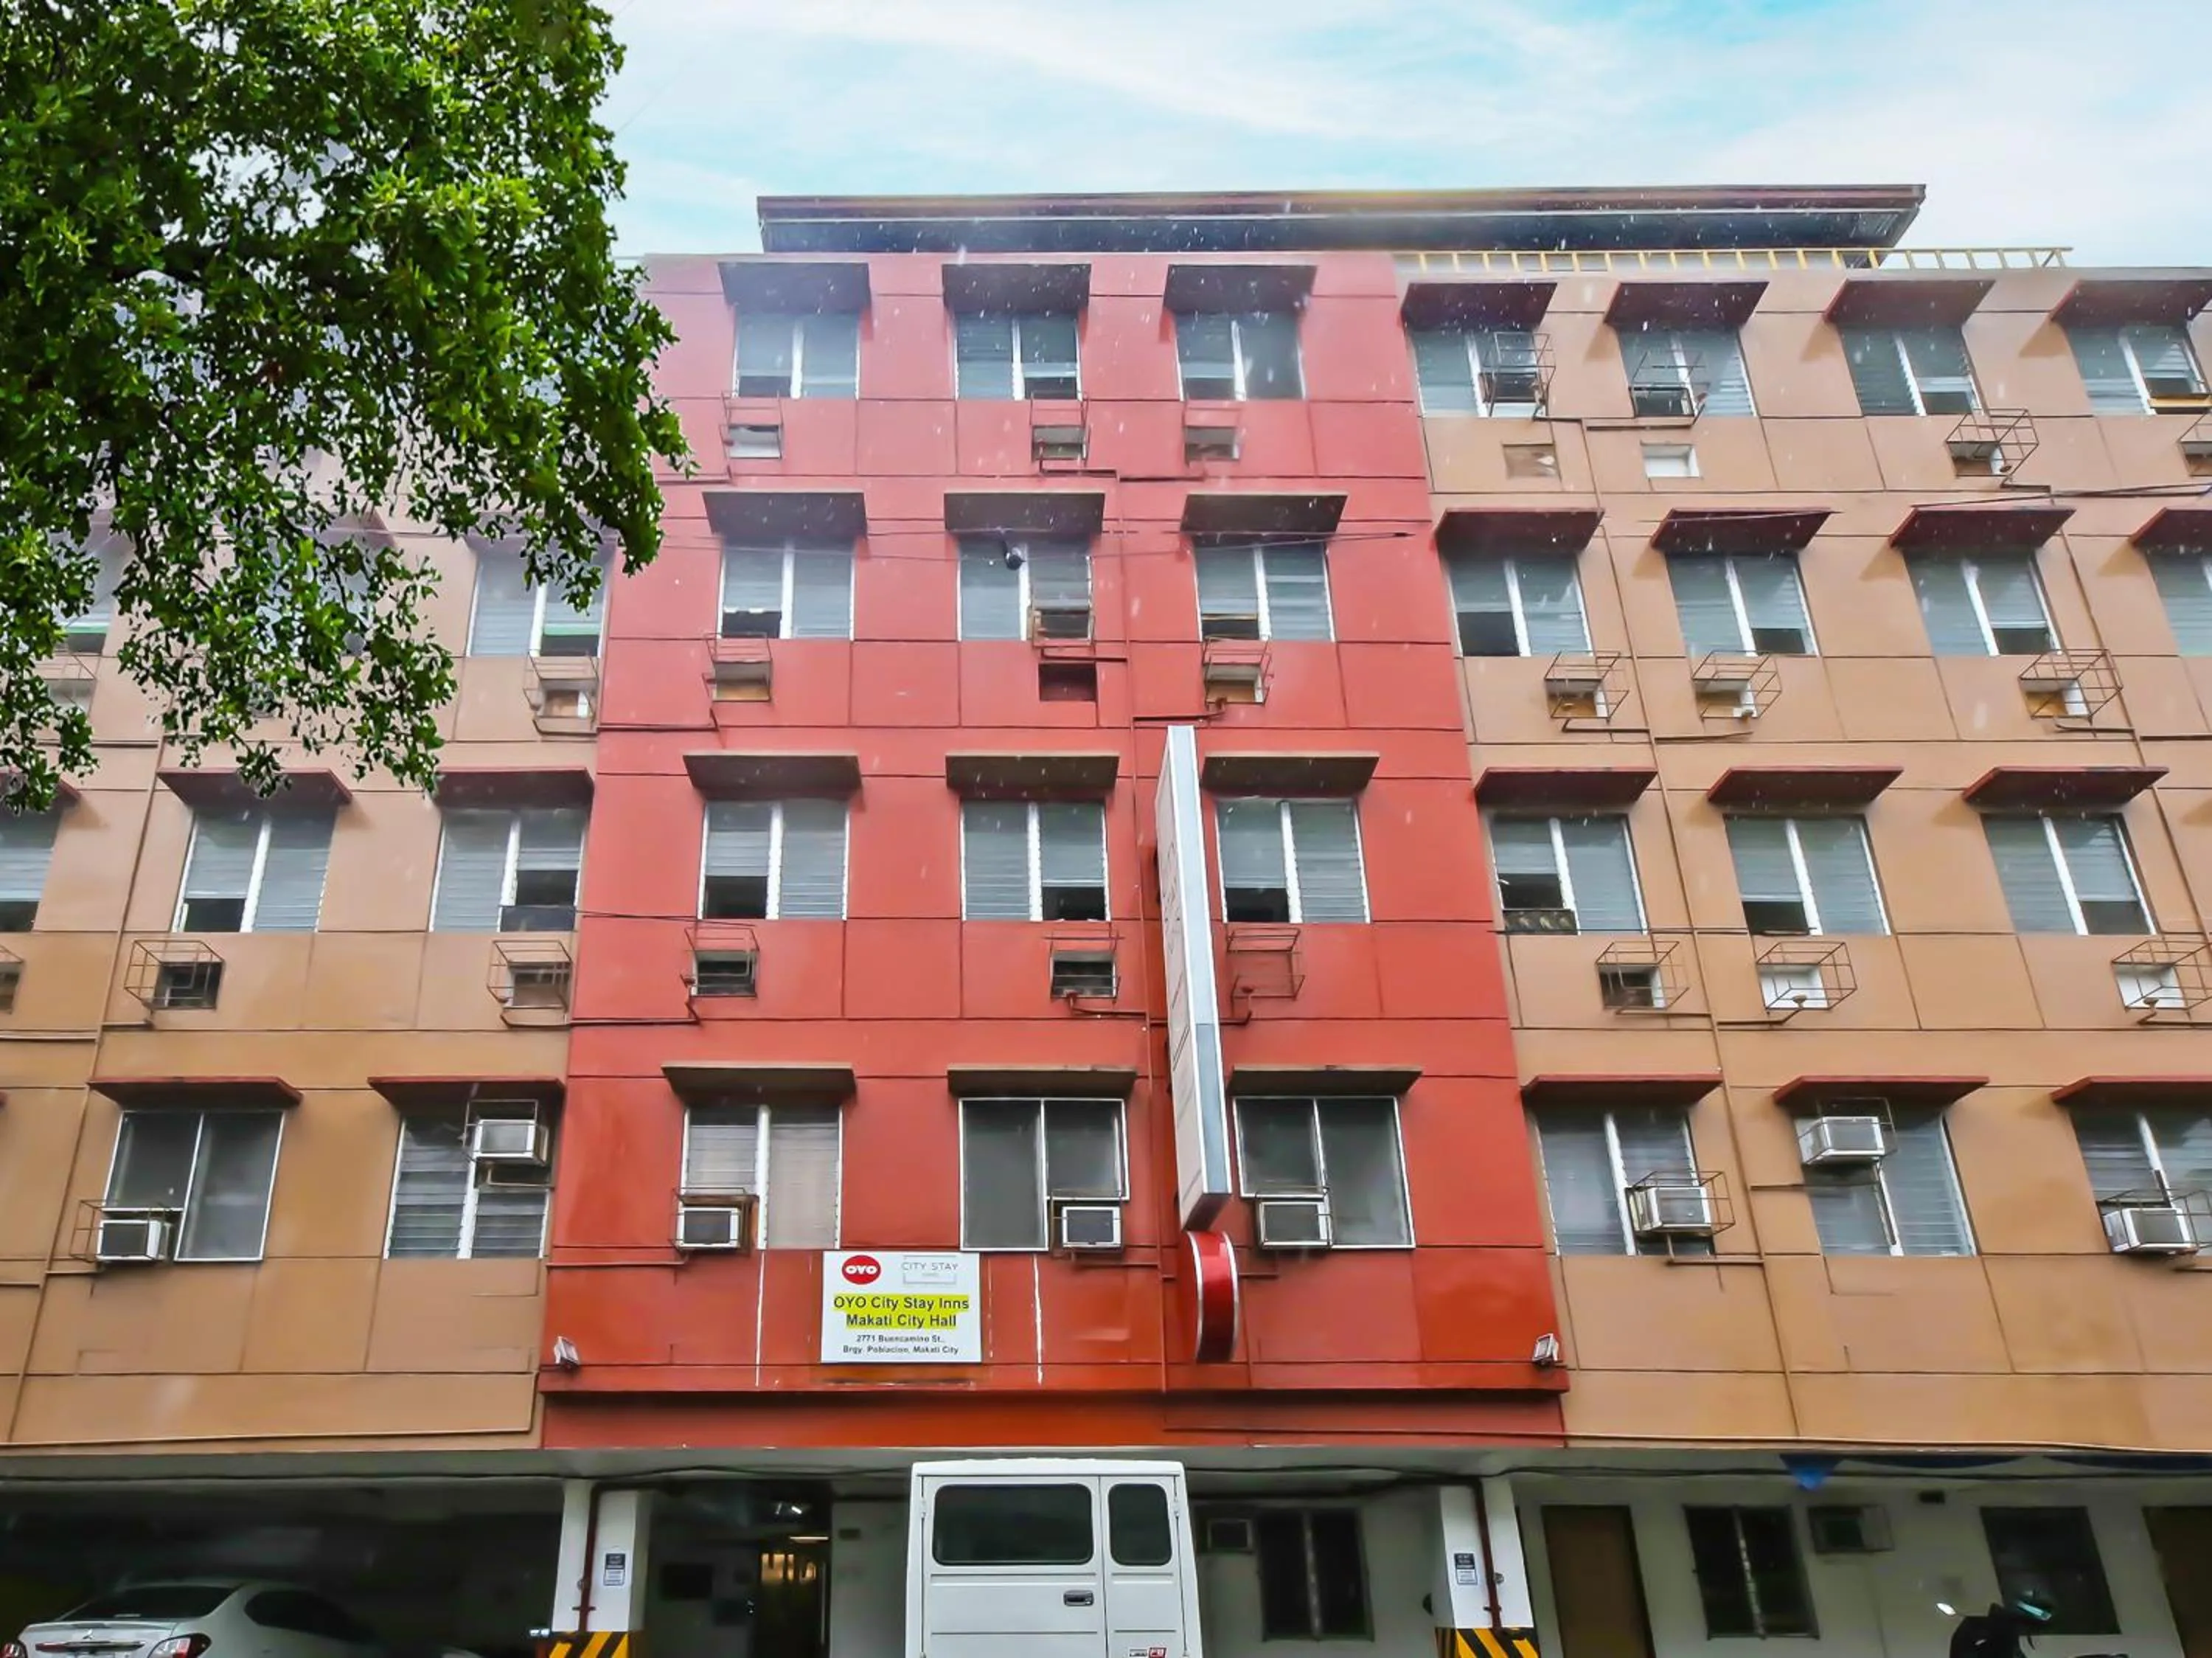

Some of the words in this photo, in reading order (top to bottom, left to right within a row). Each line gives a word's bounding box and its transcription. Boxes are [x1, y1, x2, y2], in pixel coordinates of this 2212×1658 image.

[846, 1265, 877, 1274] OYO
[902, 1262, 927, 1271] CITY
[932, 1263, 958, 1271] STAY
[834, 1297, 866, 1308] OYO
[872, 1297, 899, 1311] City
[904, 1297, 933, 1310] Stay
[939, 1297, 969, 1308] Inns
[846, 1314, 891, 1326] Makati
[897, 1315, 925, 1328] City
[931, 1315, 956, 1326] Hall
[942, 1346, 959, 1354] City
